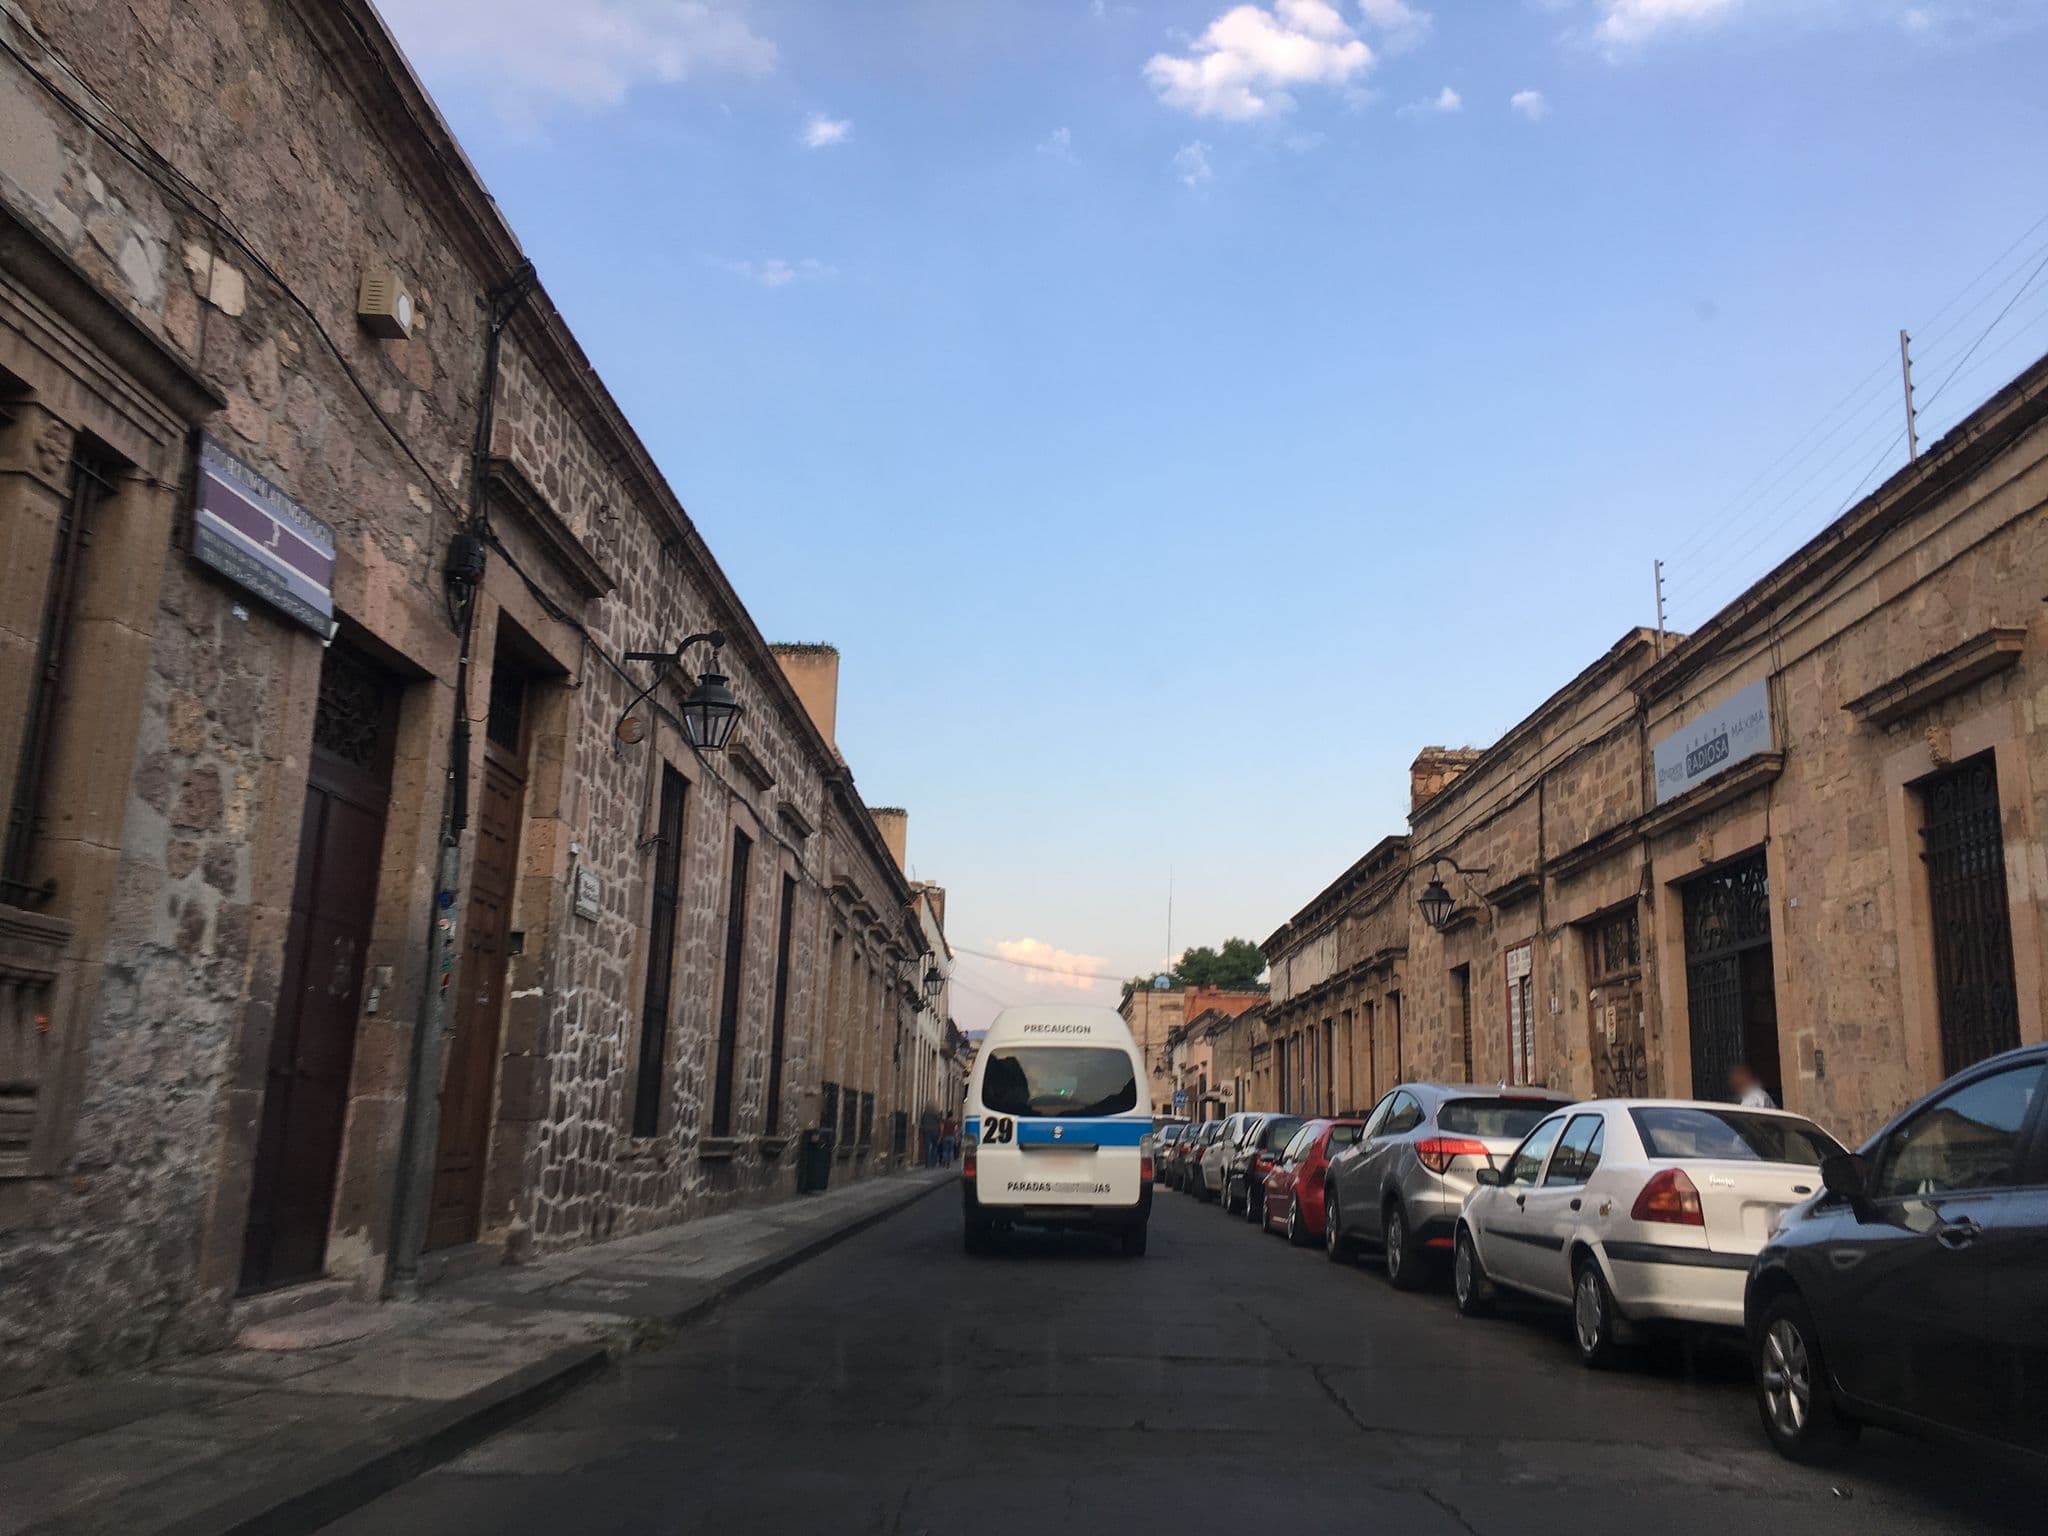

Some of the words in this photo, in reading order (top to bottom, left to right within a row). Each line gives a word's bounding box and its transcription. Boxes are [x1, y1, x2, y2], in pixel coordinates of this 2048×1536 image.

[1687, 740, 1729, 773] RADIOSA
[1023, 1023, 1092, 1035] PRECAUCION
[982, 1116, 1013, 1144] 29
[1007, 1181, 1052, 1193] PARADAS
